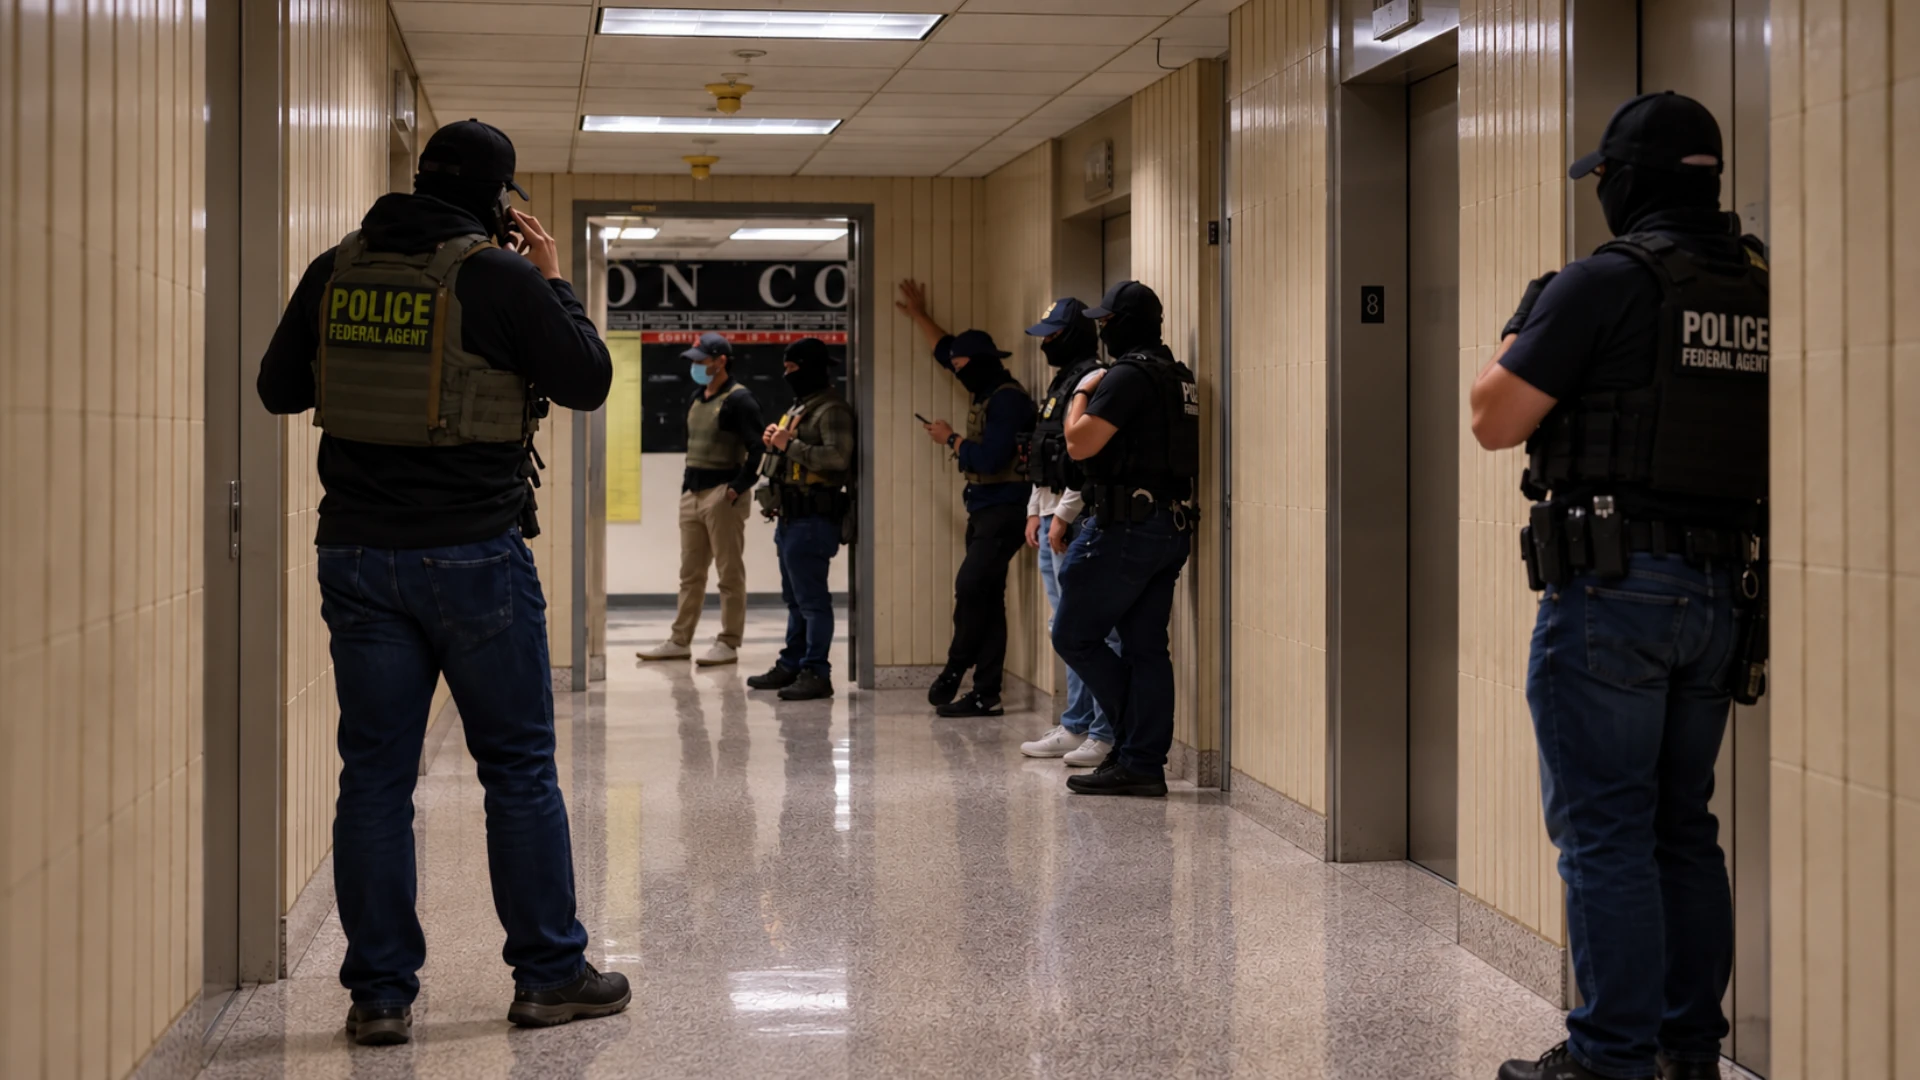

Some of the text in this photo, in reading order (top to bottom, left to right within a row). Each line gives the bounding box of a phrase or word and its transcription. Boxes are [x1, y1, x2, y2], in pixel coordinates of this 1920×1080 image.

[330, 288, 432, 326] POLICE
[1367, 293, 1378, 315] 8
[329, 323, 428, 346] FEDERAL AGENT
[1683, 310, 1769, 352] POLICE
[1682, 347, 1769, 373] FEDERAL AGENT
